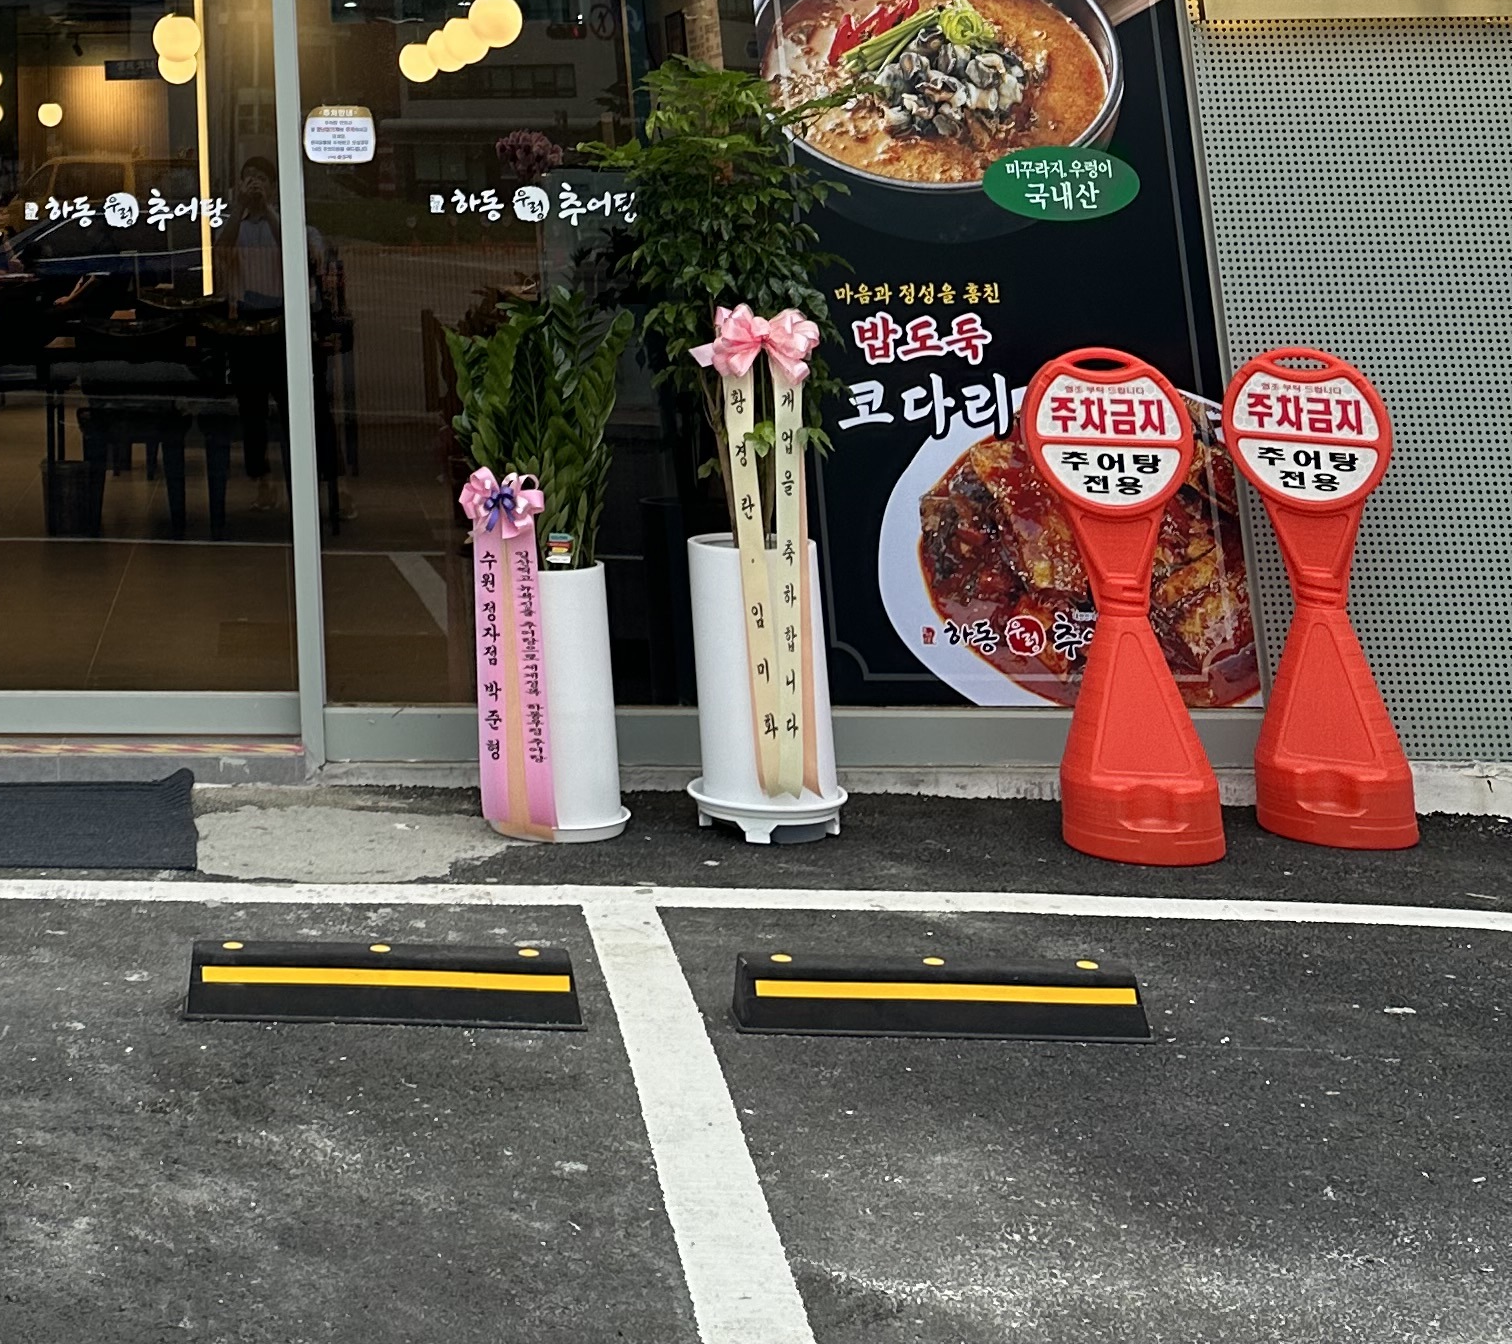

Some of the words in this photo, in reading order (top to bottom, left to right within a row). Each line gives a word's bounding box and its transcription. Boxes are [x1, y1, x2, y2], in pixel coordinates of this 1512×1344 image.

[1069, 158, 1113, 179] 우렁이
[44, 196, 96, 228] 하동
[146, 188, 228, 232] 추어탕
[450, 188, 505, 222] 하동
[1024, 181, 1100, 211] 국내산
[834, 282, 893, 305] 마음과
[898, 282, 957, 305] 정성을
[962, 282, 1001, 305] 훔친
[852, 311, 992, 365] 밥도둑
[838, 372, 1009, 436] 코다리
[1050, 397, 1166, 435] 주차금지
[1247, 393, 1363, 435] 주차금지
[781, 388, 795, 496] 개업을
[1257, 447, 1359, 472] 추어탕
[1061, 451, 1161, 474] 추어탕
[1279, 470, 1340, 492] 전용
[1083, 475, 1143, 495] 전용
[479, 550, 498, 594] 수원
[730, 388, 755, 520] 황경란
[751, 602, 779, 741] 임미화
[482, 600, 501, 667] 정자점
[782, 539, 799, 741] 축하합니다
[944, 620, 1000, 654] 하동
